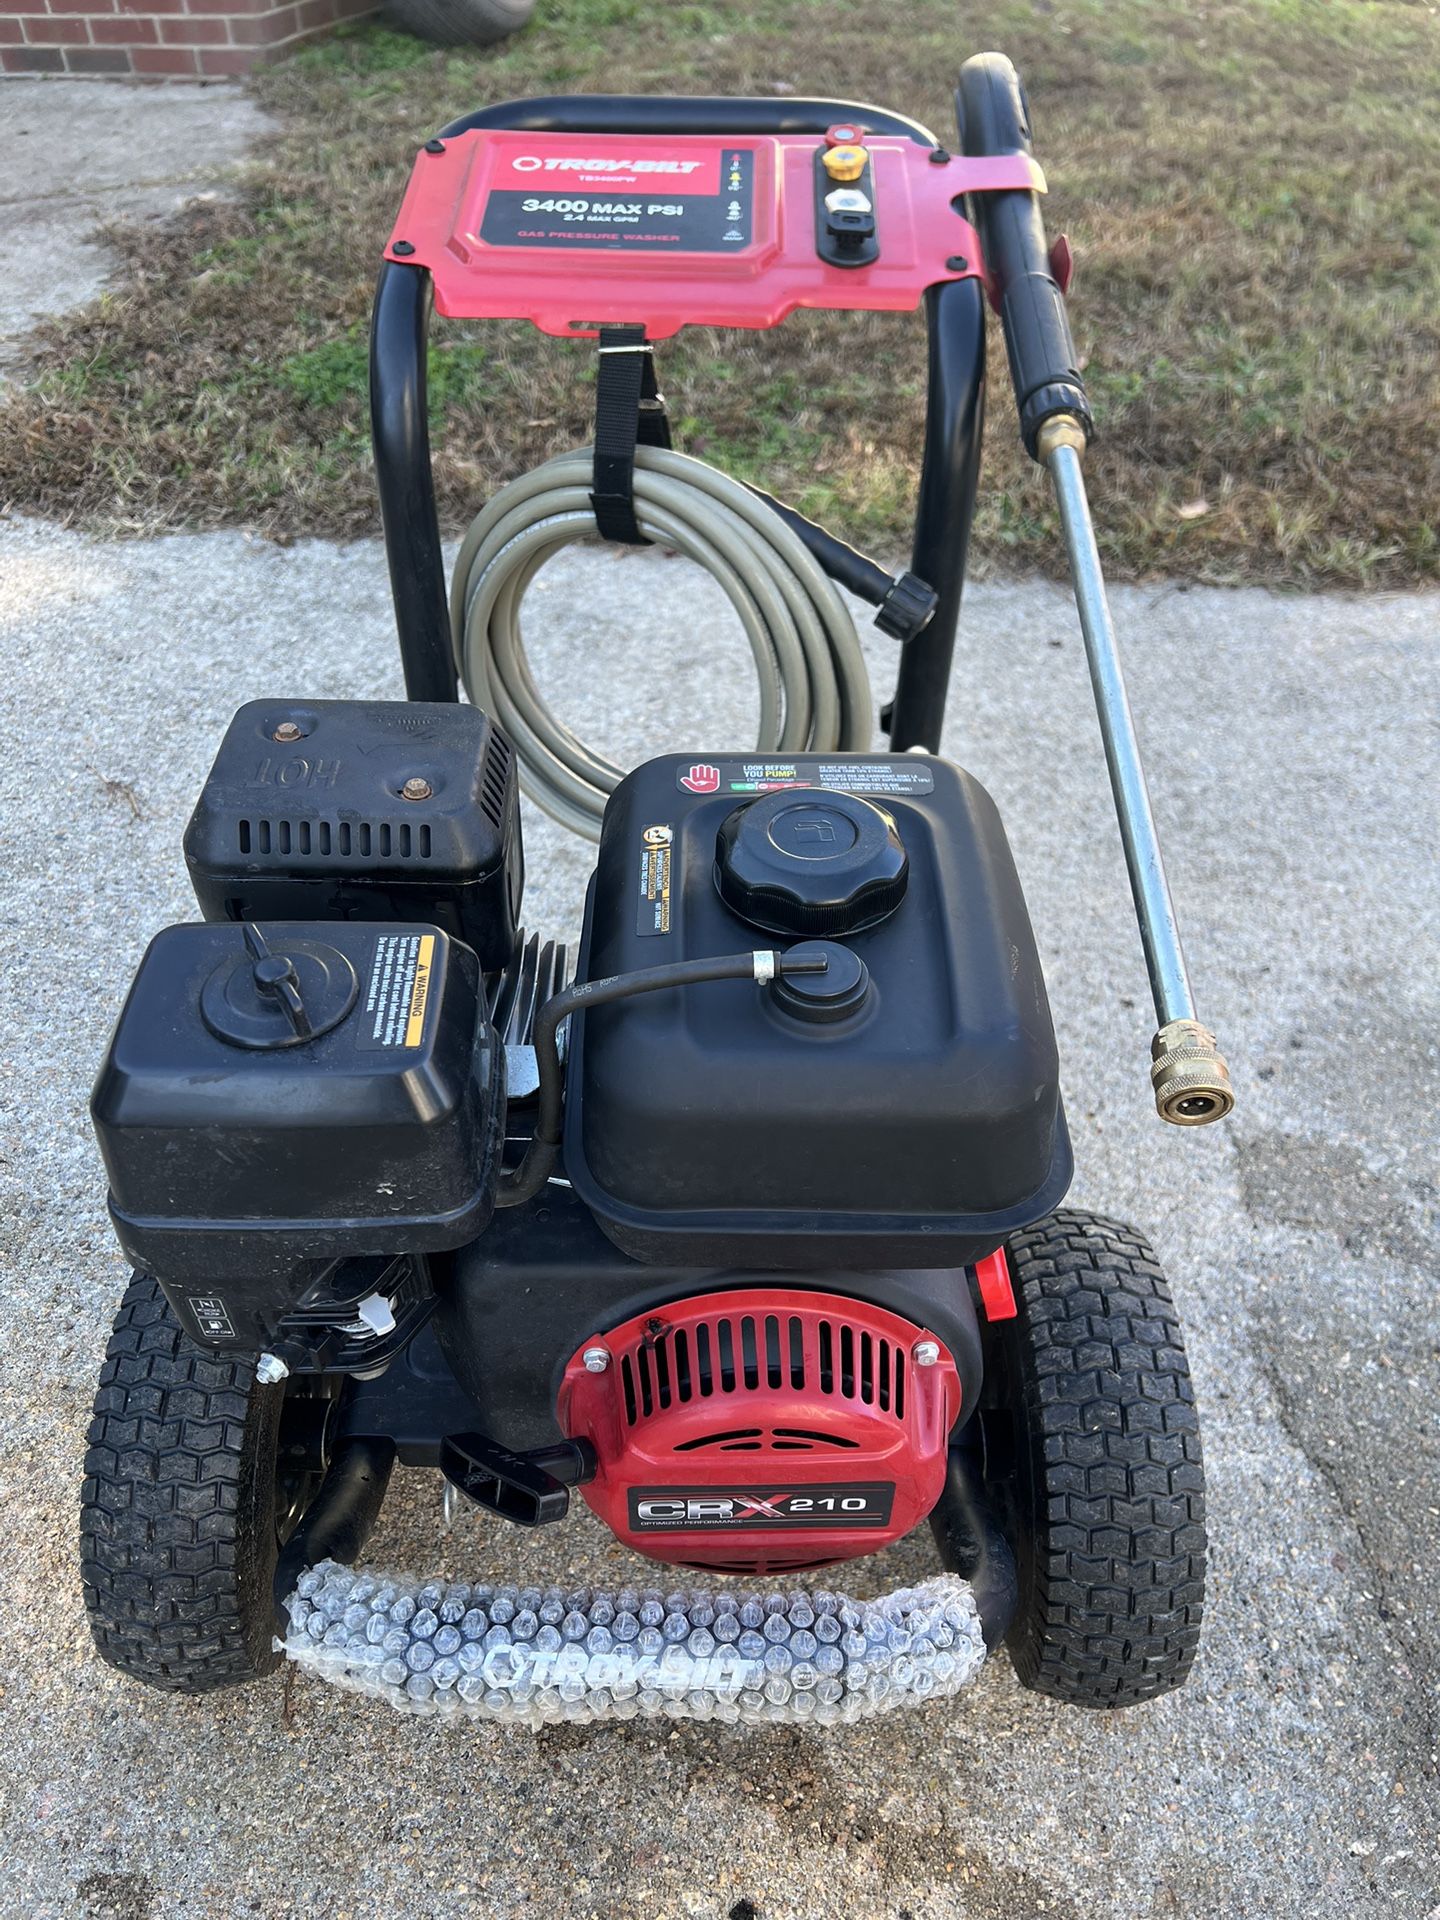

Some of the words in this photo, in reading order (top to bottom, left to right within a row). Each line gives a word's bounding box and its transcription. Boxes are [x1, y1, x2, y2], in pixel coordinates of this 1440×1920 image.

[544, 158, 702, 173] TROY-BILT
[521, 199, 589, 213] 3400
[591, 203, 642, 215] MAX
[647, 205, 684, 216] PSI
[563, 213, 585, 222] 2.4
[517, 230, 545, 238] GAS
[548, 231, 619, 240] PRESSURE
[623, 234, 681, 242] WASHER
[246, 756, 342, 789] HOT
[388, 937, 398, 947] This
[400, 937, 410, 947] Turn
[409, 937, 420, 957] Gasoline
[375, 953, 383, 962] run
[385, 948, 395, 964] engine
[397, 948, 407, 964] engine
[383, 965, 392, 979] emits
[394, 973, 403, 982] and
[404, 965, 416, 980] highly
[369, 975, 380, 998] enclosed
[381, 980, 390, 992] toxic
[401, 981, 413, 1007] flammable
[378, 993, 388, 1011] carbon
[391, 991, 400, 1002] cool
[412, 976, 427, 1016] WARNING
[366, 999, 375, 1012] area.
[388, 1003, 399, 1019] before
[400, 1008, 408, 1018] and
[373, 1012, 384, 1039] monoxide.
[382, 1021, 396, 1046] refueling.
[395, 1019, 406, 1046] explosive.
[638, 1494, 793, 1520] CRX
[790, 1498, 867, 1511] 210
